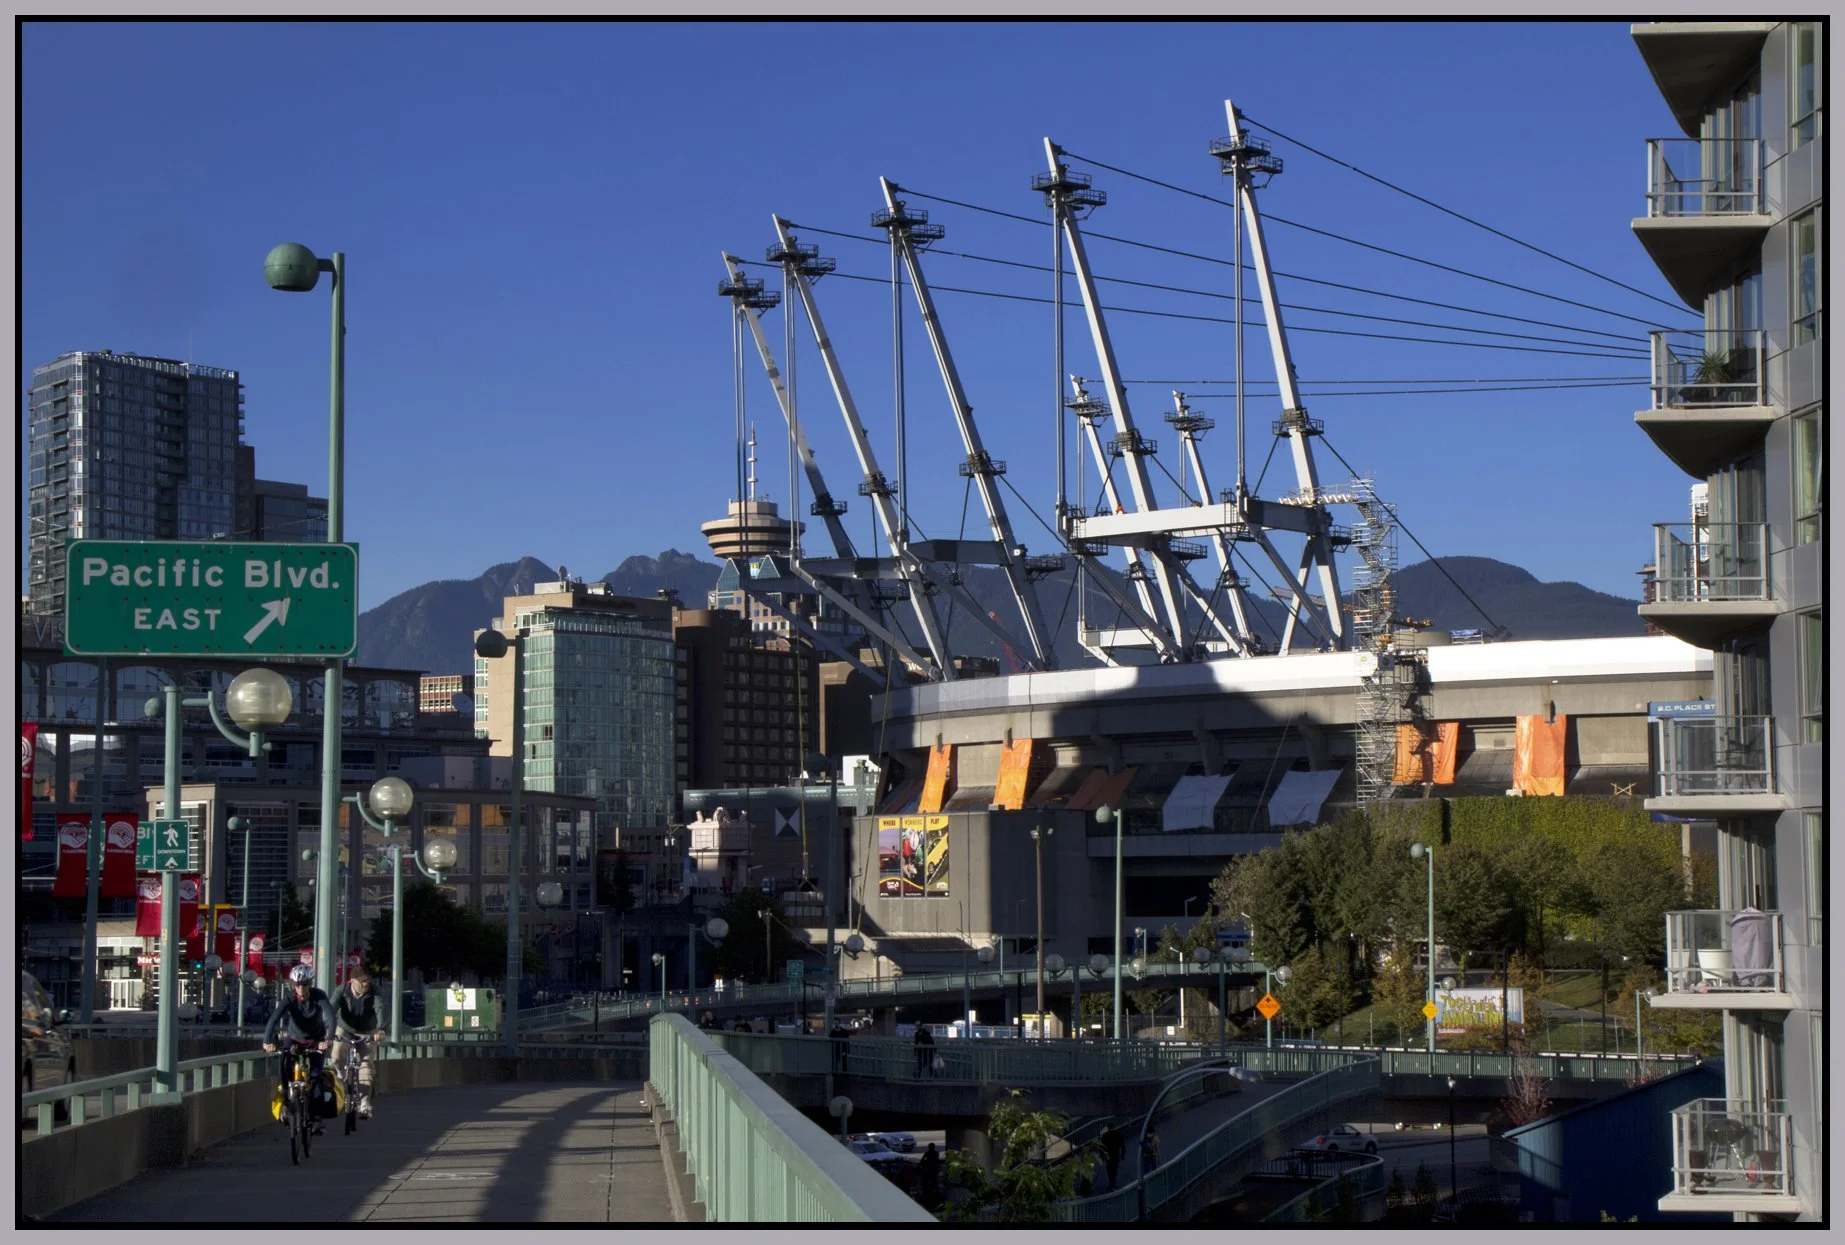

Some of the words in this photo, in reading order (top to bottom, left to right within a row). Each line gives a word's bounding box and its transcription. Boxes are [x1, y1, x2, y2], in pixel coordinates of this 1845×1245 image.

[82, 557, 224, 588] Pacific
[244, 559, 340, 589] Blvd.
[134, 607, 222, 631] EAST
